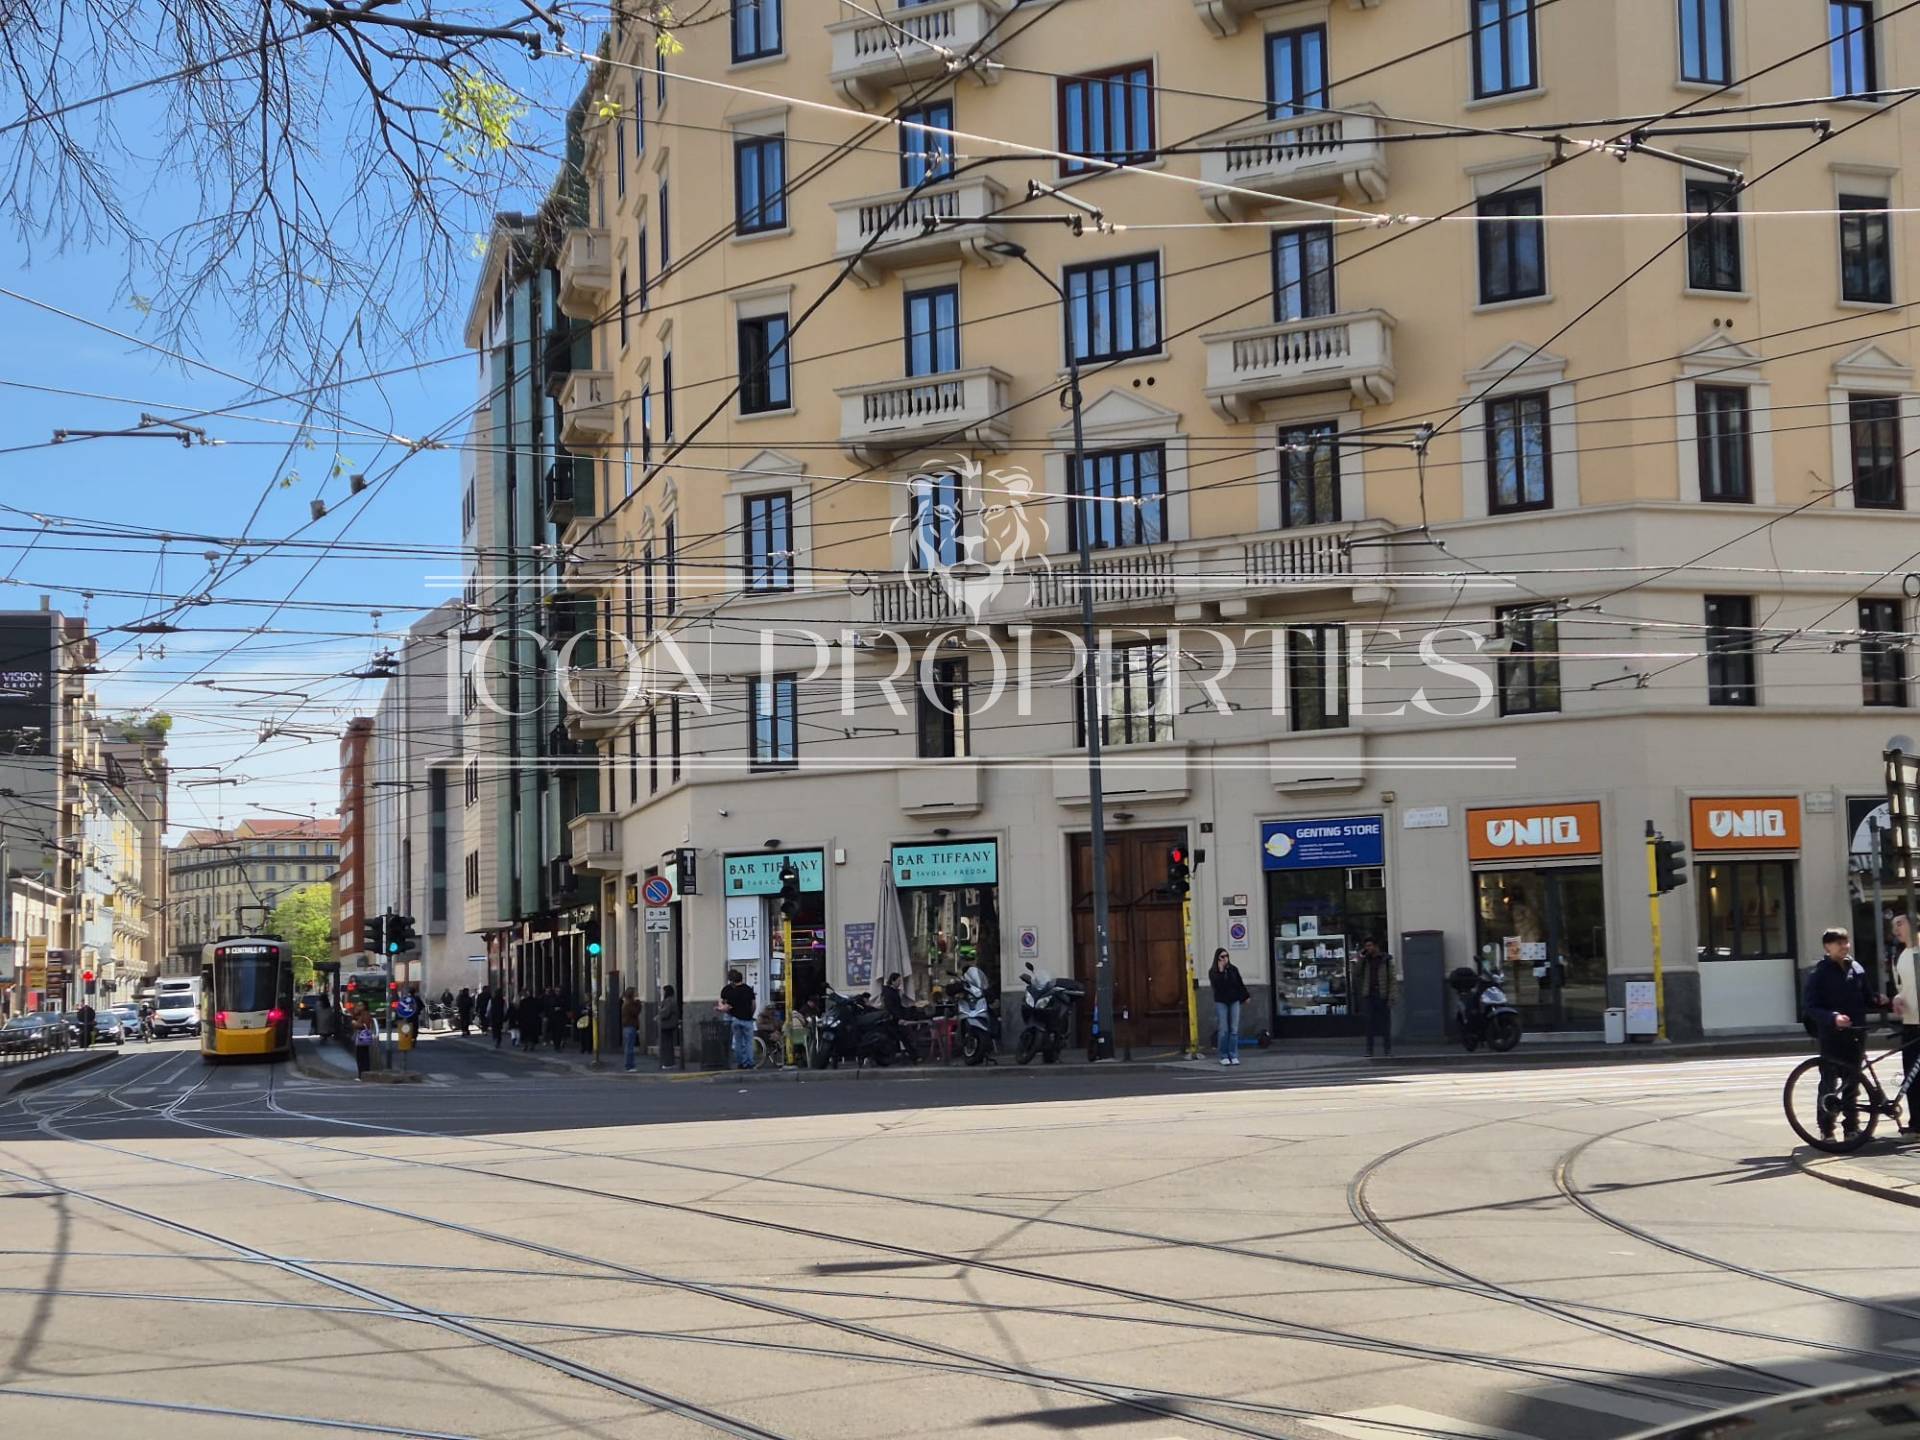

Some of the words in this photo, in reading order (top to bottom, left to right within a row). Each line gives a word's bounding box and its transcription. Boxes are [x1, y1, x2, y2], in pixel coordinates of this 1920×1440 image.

[1, 671, 43, 681] VISION
[1486, 815, 1580, 847] UNIQ
[1708, 809, 1786, 838] UNIQ
[1296, 826, 1342, 839] GENTING
[1343, 824, 1380, 836] STORE
[897, 854, 924, 865] BAR
[931, 850, 991, 864] TIFFANY
[729, 863, 755, 875] BAR
[761, 859, 818, 873] TIFANY
[747, 877, 812, 887] TABACCIA
[728, 915, 758, 930] SELF
[730, 929, 757, 942] H24
